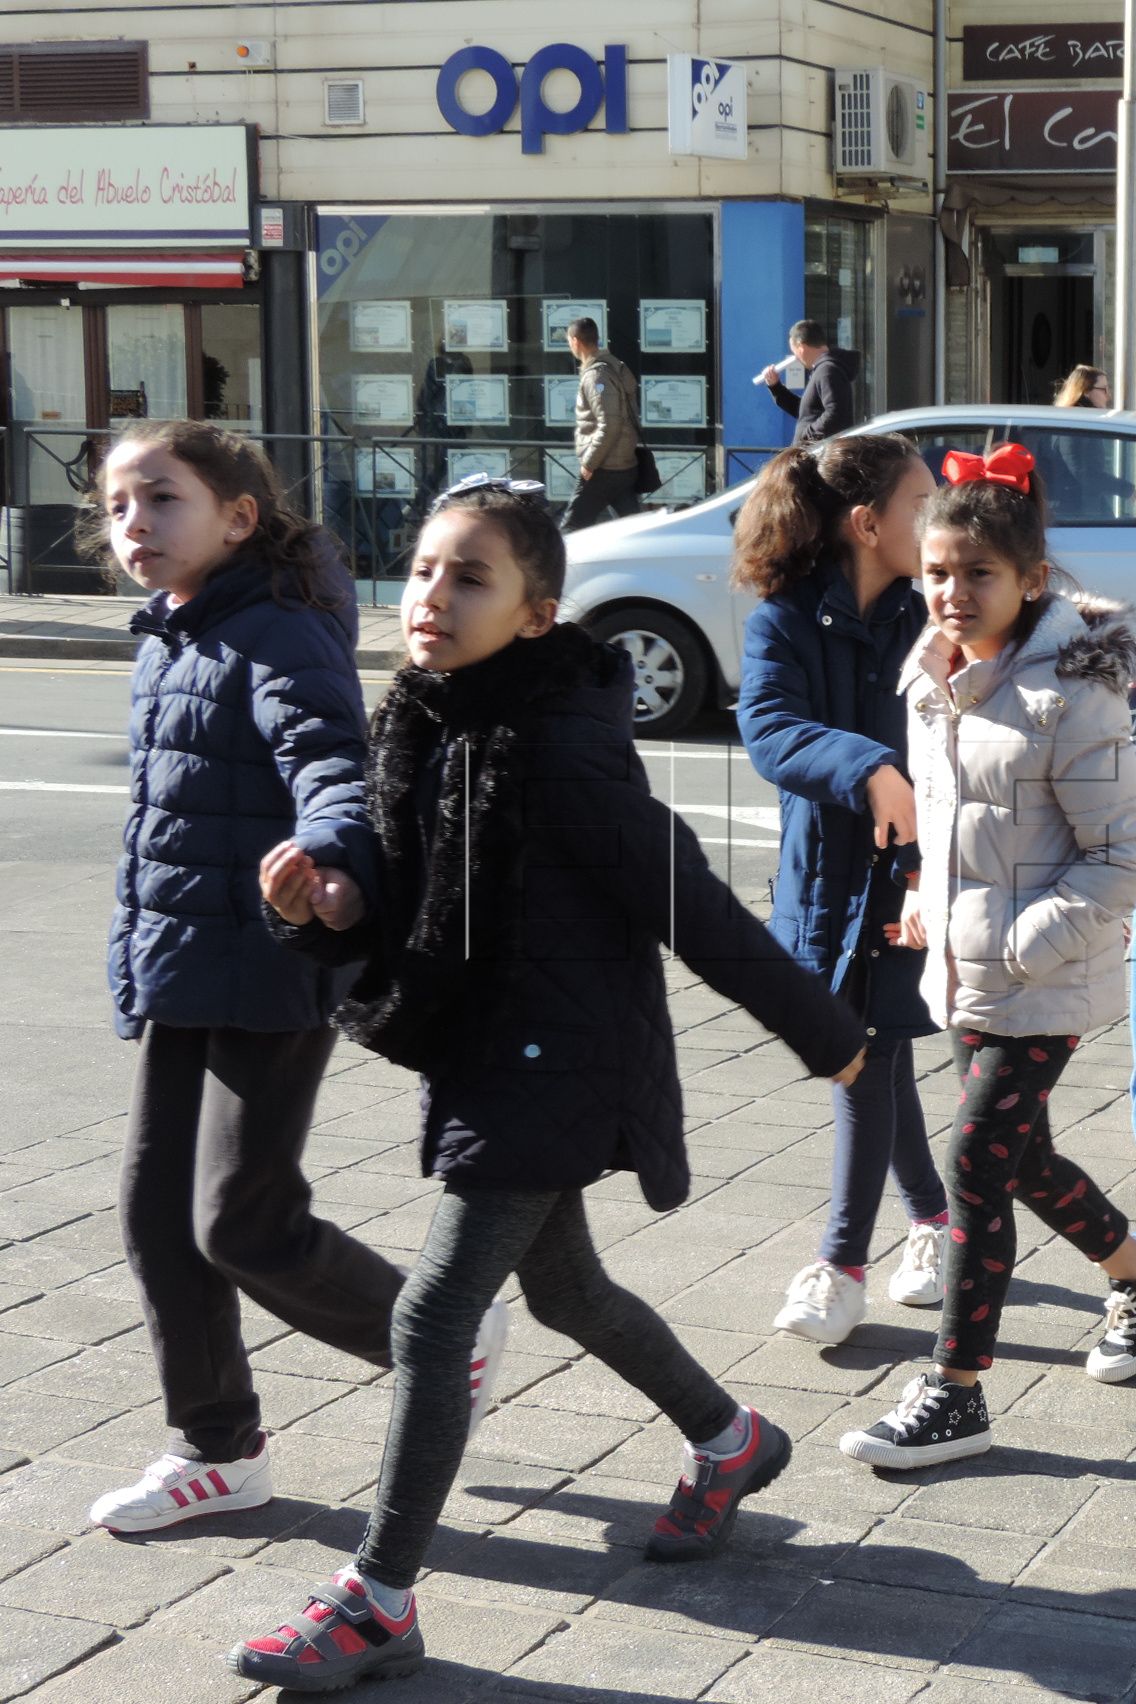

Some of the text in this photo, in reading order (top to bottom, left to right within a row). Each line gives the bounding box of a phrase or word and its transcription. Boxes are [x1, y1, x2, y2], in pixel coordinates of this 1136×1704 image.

[717, 96, 733, 122] opi
[950, 94, 1014, 151] El
[56, 168, 85, 205] del
[94, 167, 152, 208] Abuelo
[159, 165, 238, 205] Cristóbal
